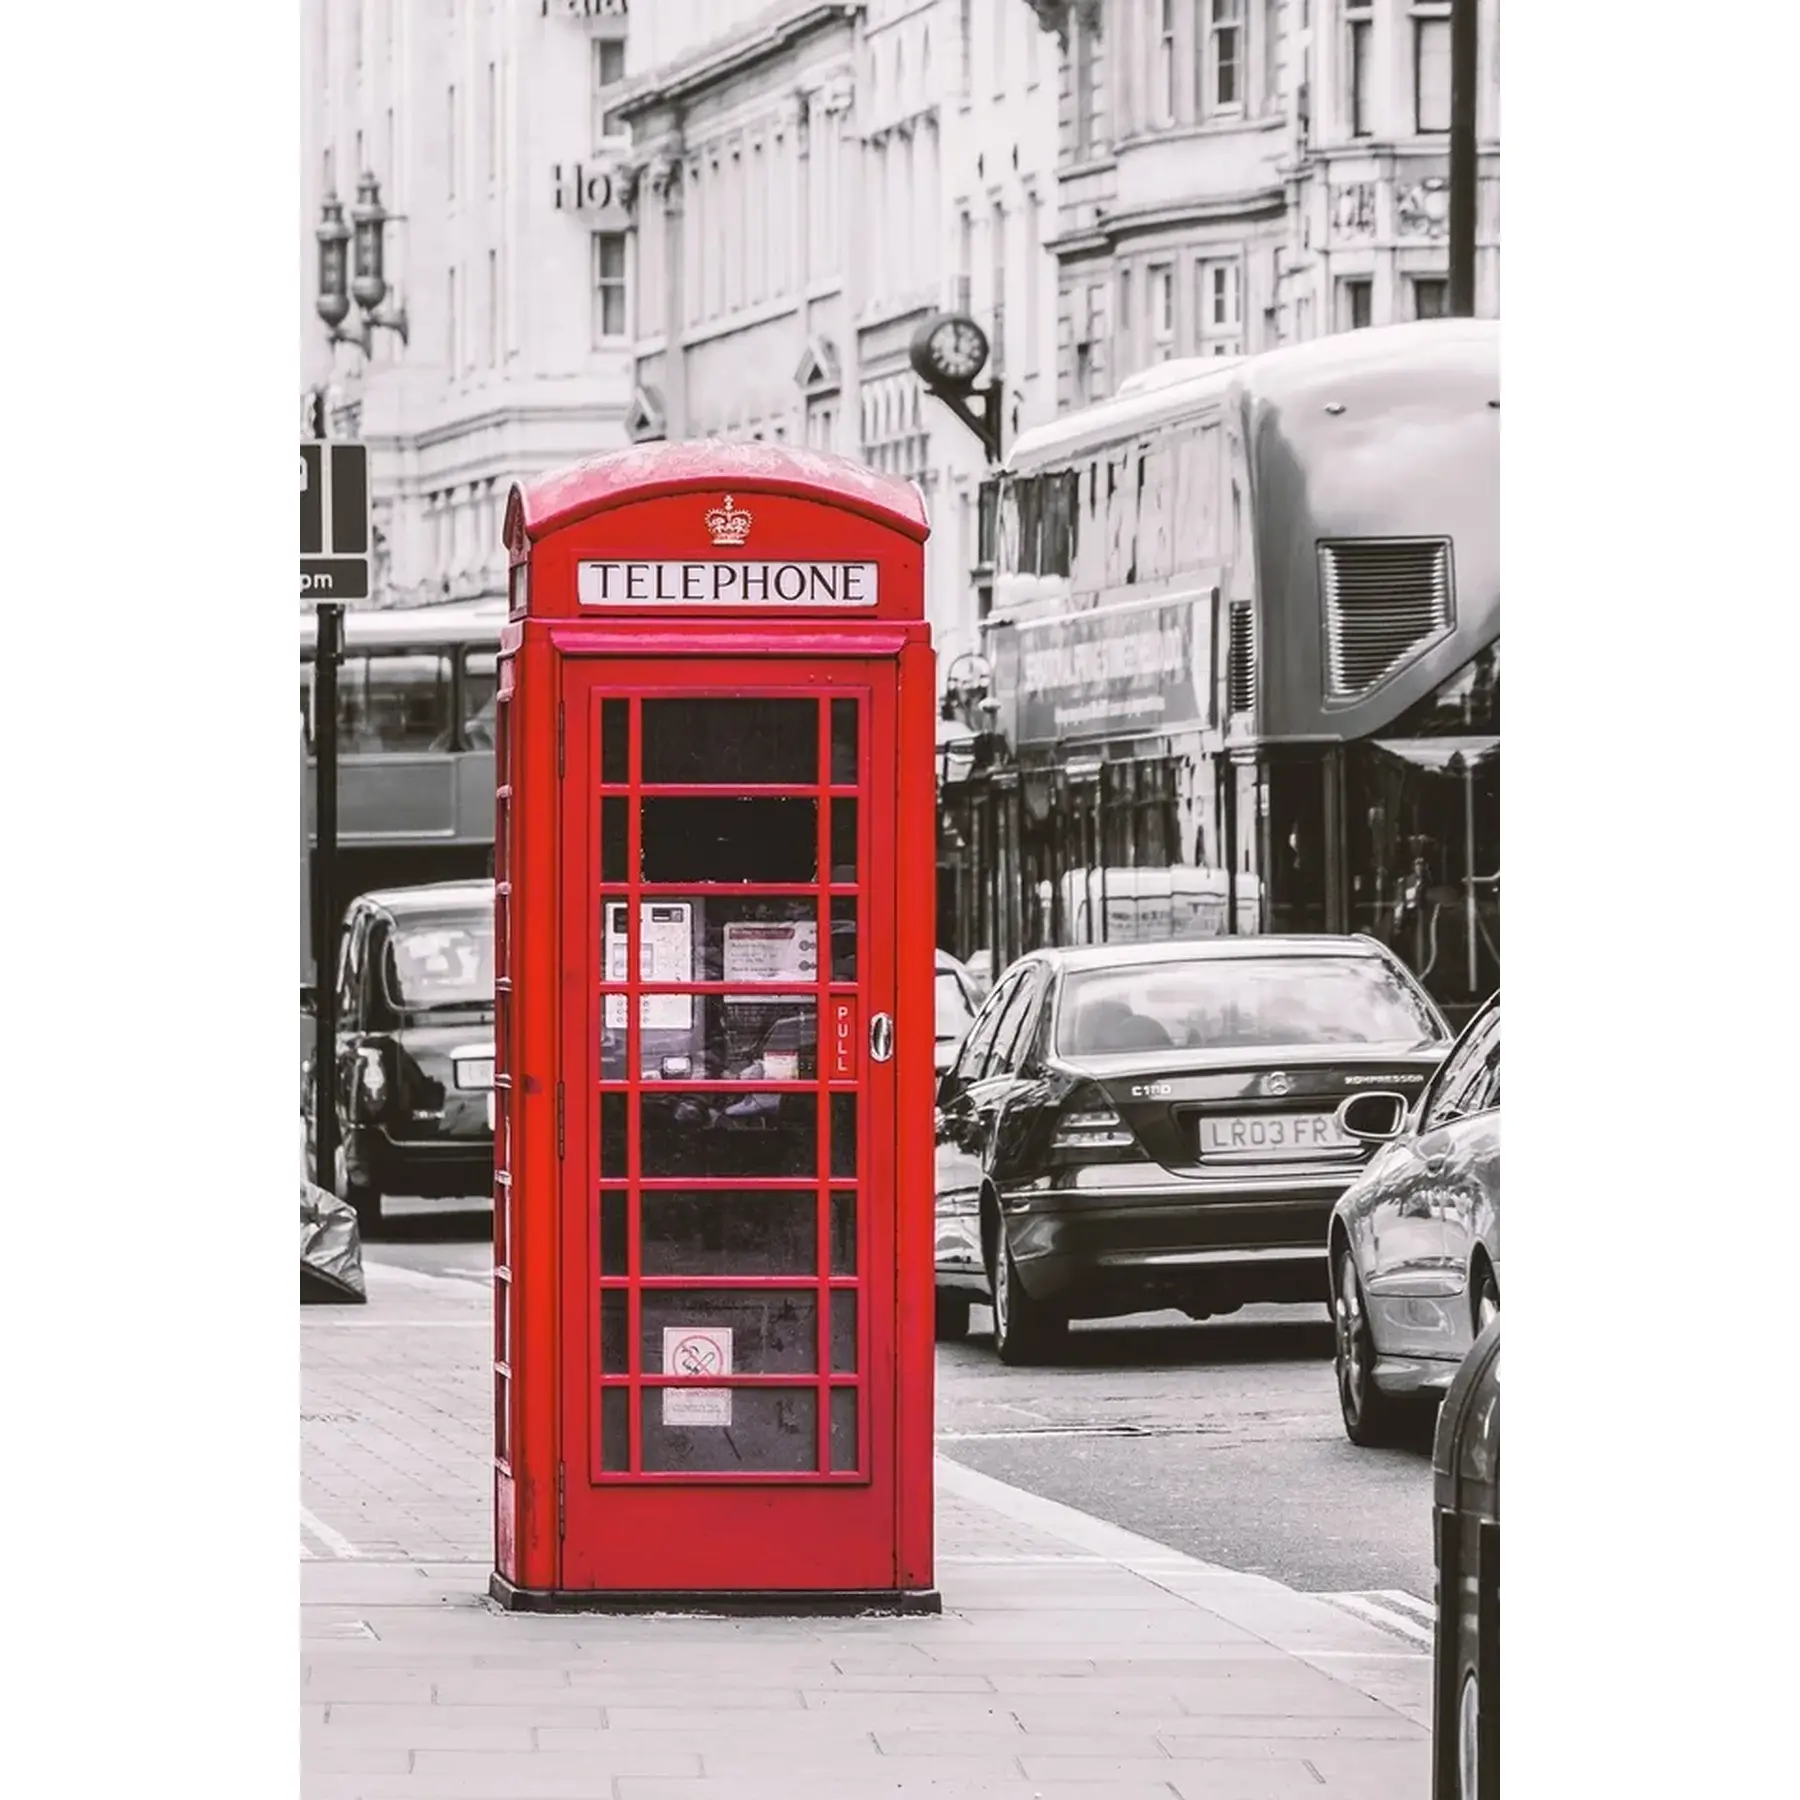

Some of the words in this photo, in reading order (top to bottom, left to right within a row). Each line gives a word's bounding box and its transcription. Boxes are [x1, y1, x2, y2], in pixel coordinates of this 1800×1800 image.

[590, 564, 865, 600] TELEPHONE
[837, 1006, 849, 1072] PULL
[1212, 1121, 1284, 1147] LR03
